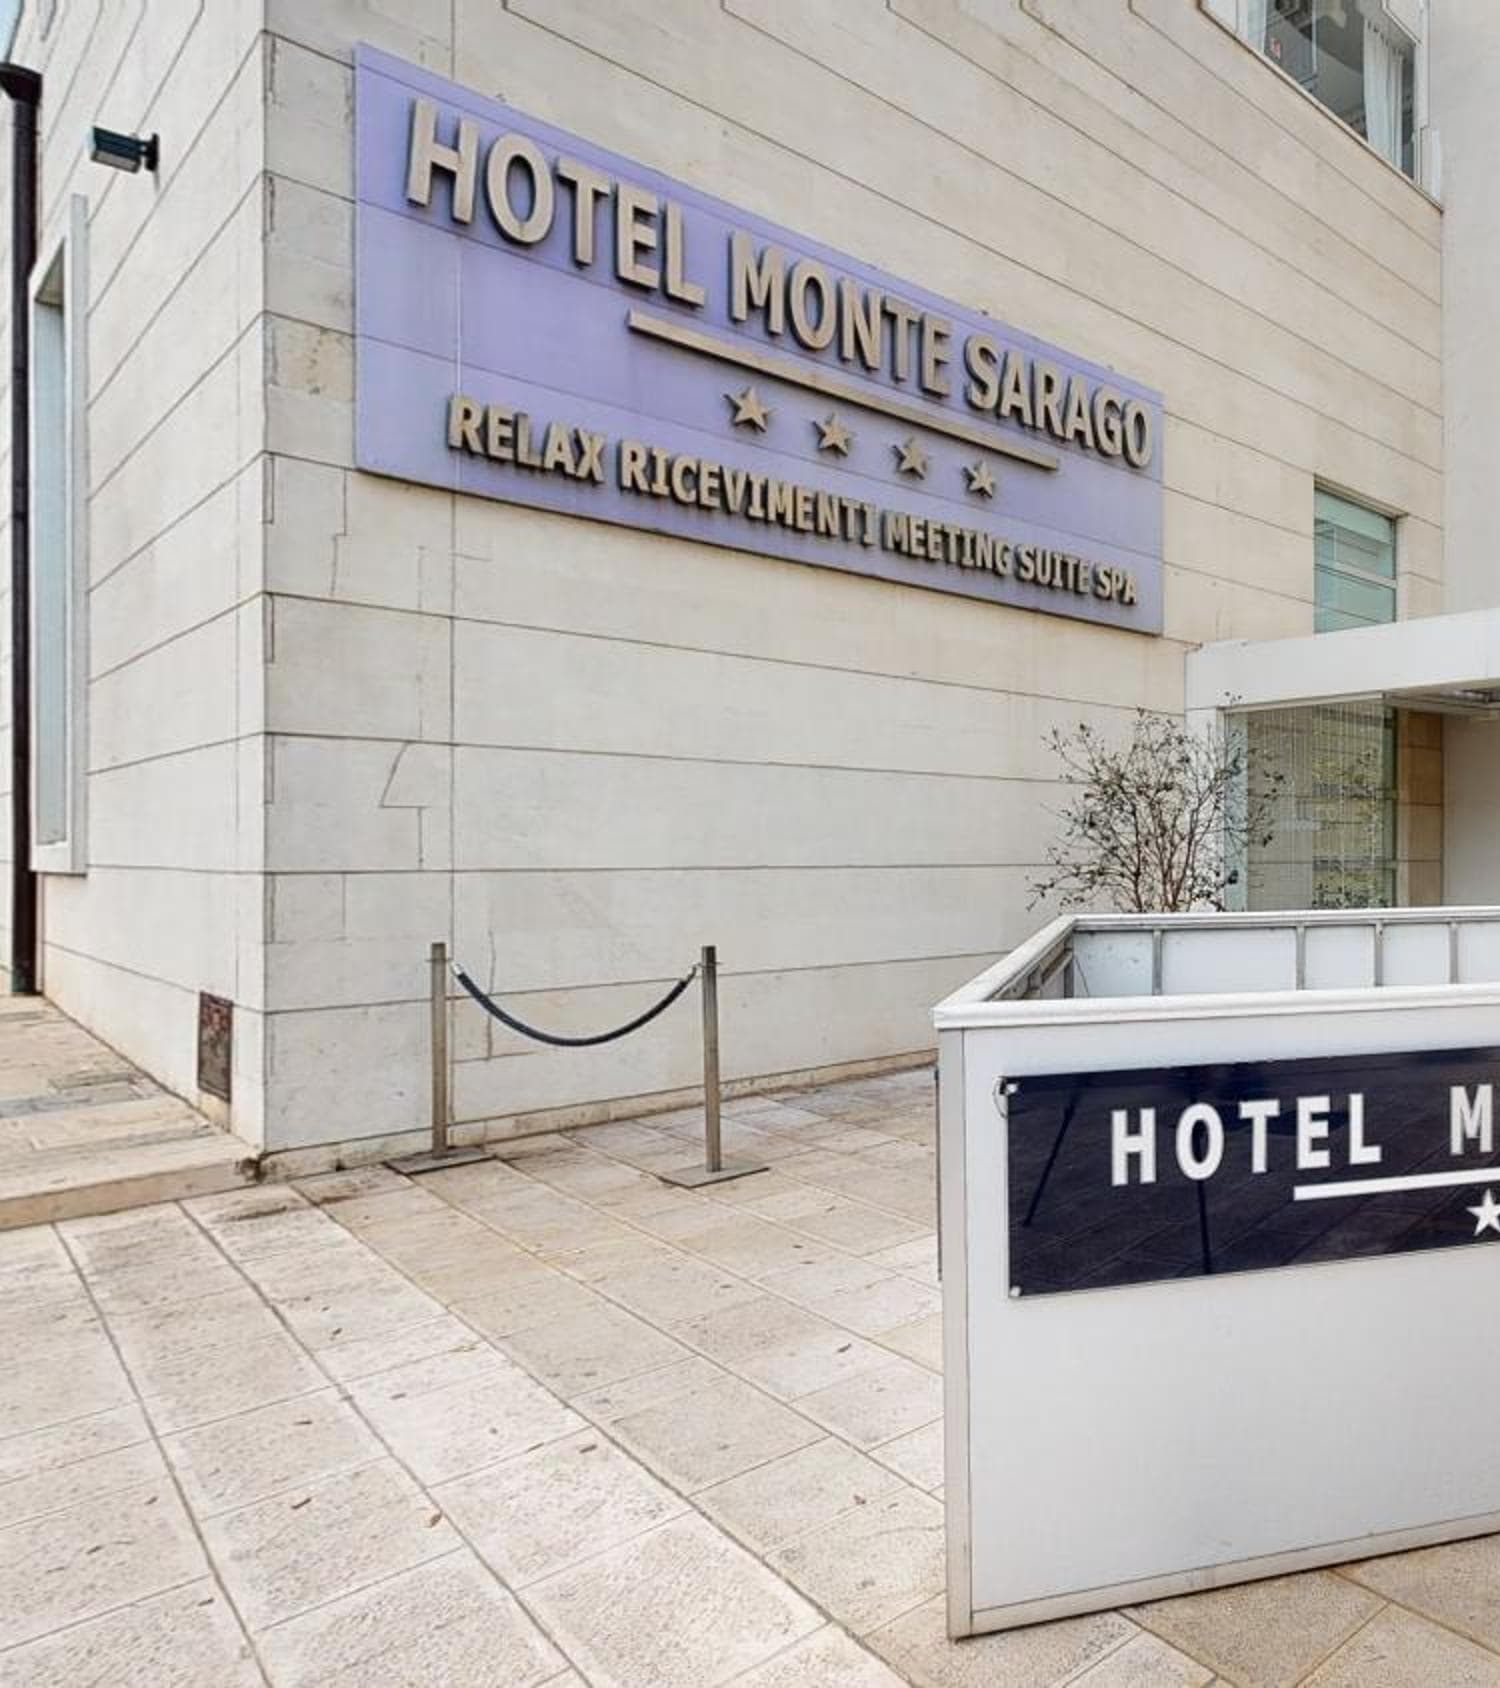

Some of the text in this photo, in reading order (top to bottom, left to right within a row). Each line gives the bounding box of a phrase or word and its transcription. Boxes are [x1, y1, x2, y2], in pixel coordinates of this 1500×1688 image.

[404, 97, 1154, 468] HOTEL MONTE SARAGO
[446, 396, 1139, 606] RELAX RICEVIMENTI MEETING SUITE SPA
[1110, 1092, 1382, 1186] HOTEL
